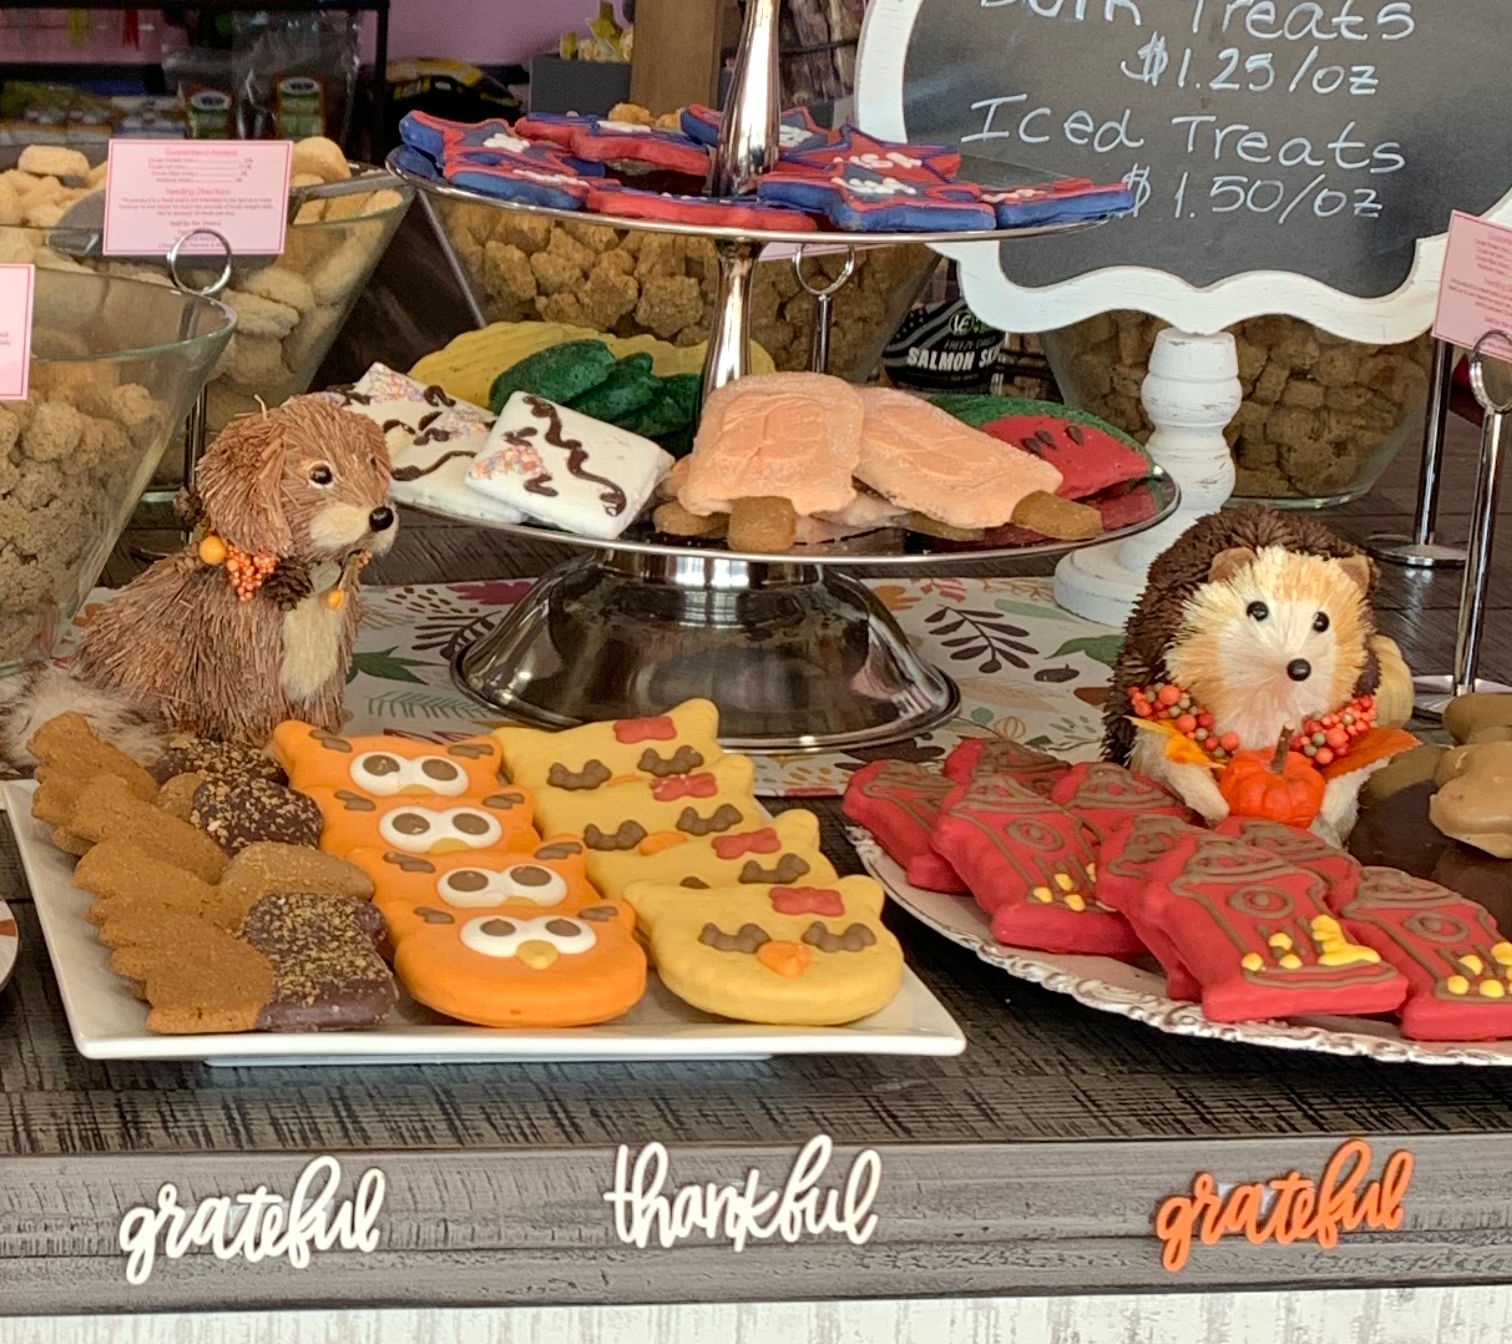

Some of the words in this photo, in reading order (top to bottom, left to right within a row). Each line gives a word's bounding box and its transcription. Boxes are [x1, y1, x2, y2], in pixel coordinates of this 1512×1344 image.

[1120, 31, 1380, 96] $1.25/oz
[960, 93, 1145, 153] Iced
[1172, 115, 1407, 174] Treats
[906, 346, 975, 372] SALMON
[119, 1155, 385, 1286] grateful
[603, 1134, 882, 1252] thankful
[1155, 1135, 1415, 1273] grateful
